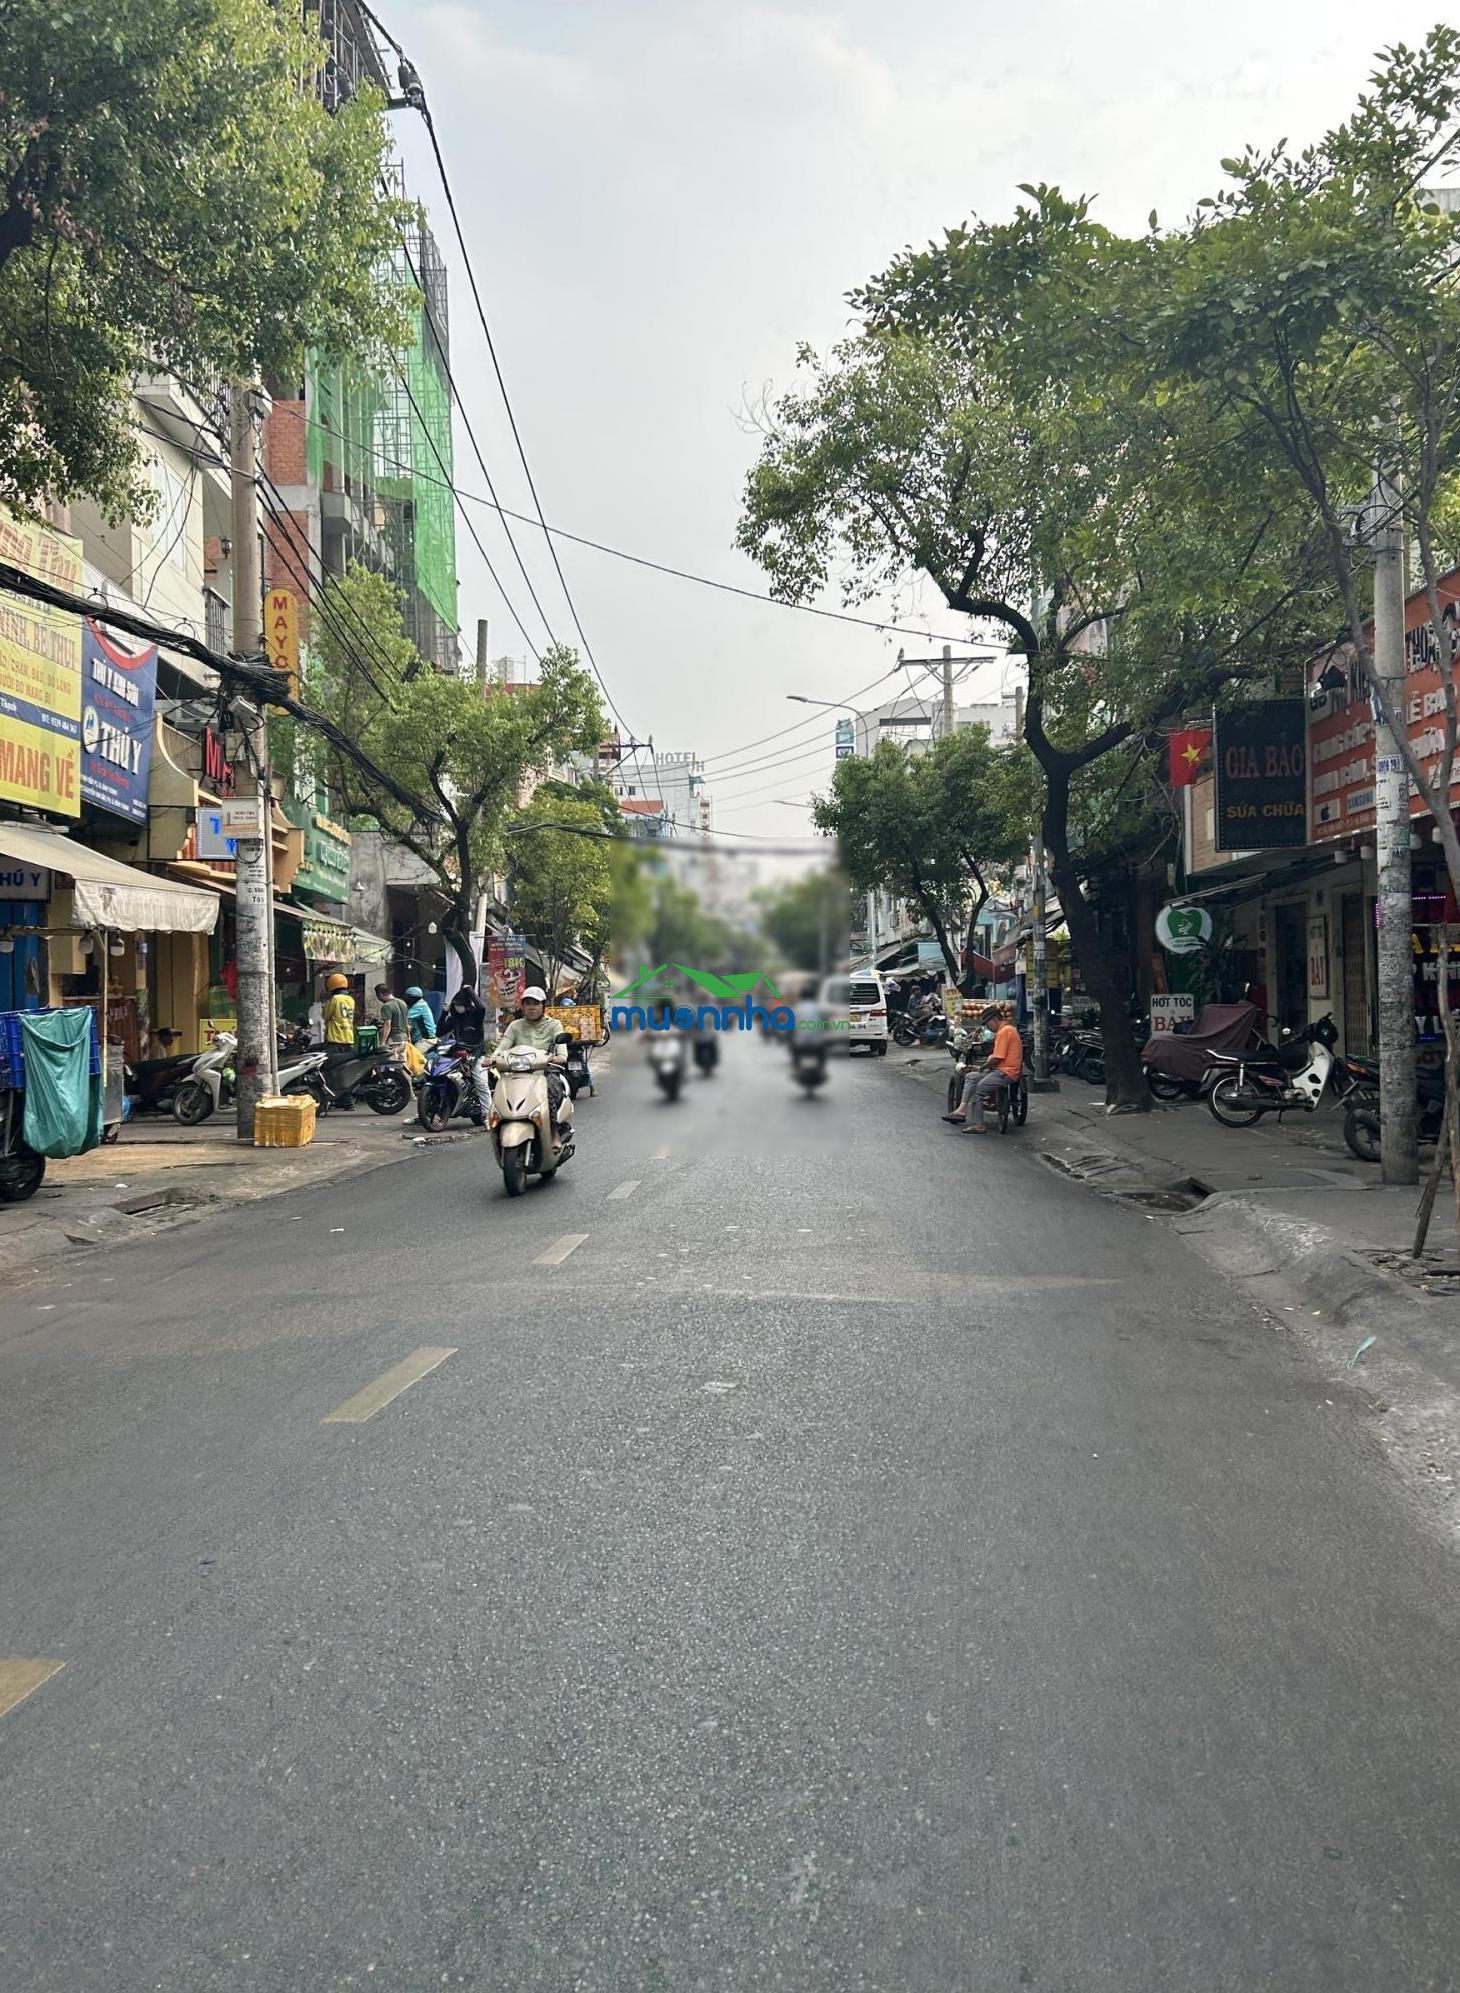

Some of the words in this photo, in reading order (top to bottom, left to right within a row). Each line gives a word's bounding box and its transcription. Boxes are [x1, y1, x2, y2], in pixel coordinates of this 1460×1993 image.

[0, 738, 50, 793] MANG
[131, 738, 143, 776] Y
[655, 752, 700, 766] HOTEL
[1225, 745, 1260, 779] GIA
[31, 872, 42, 887] Y
